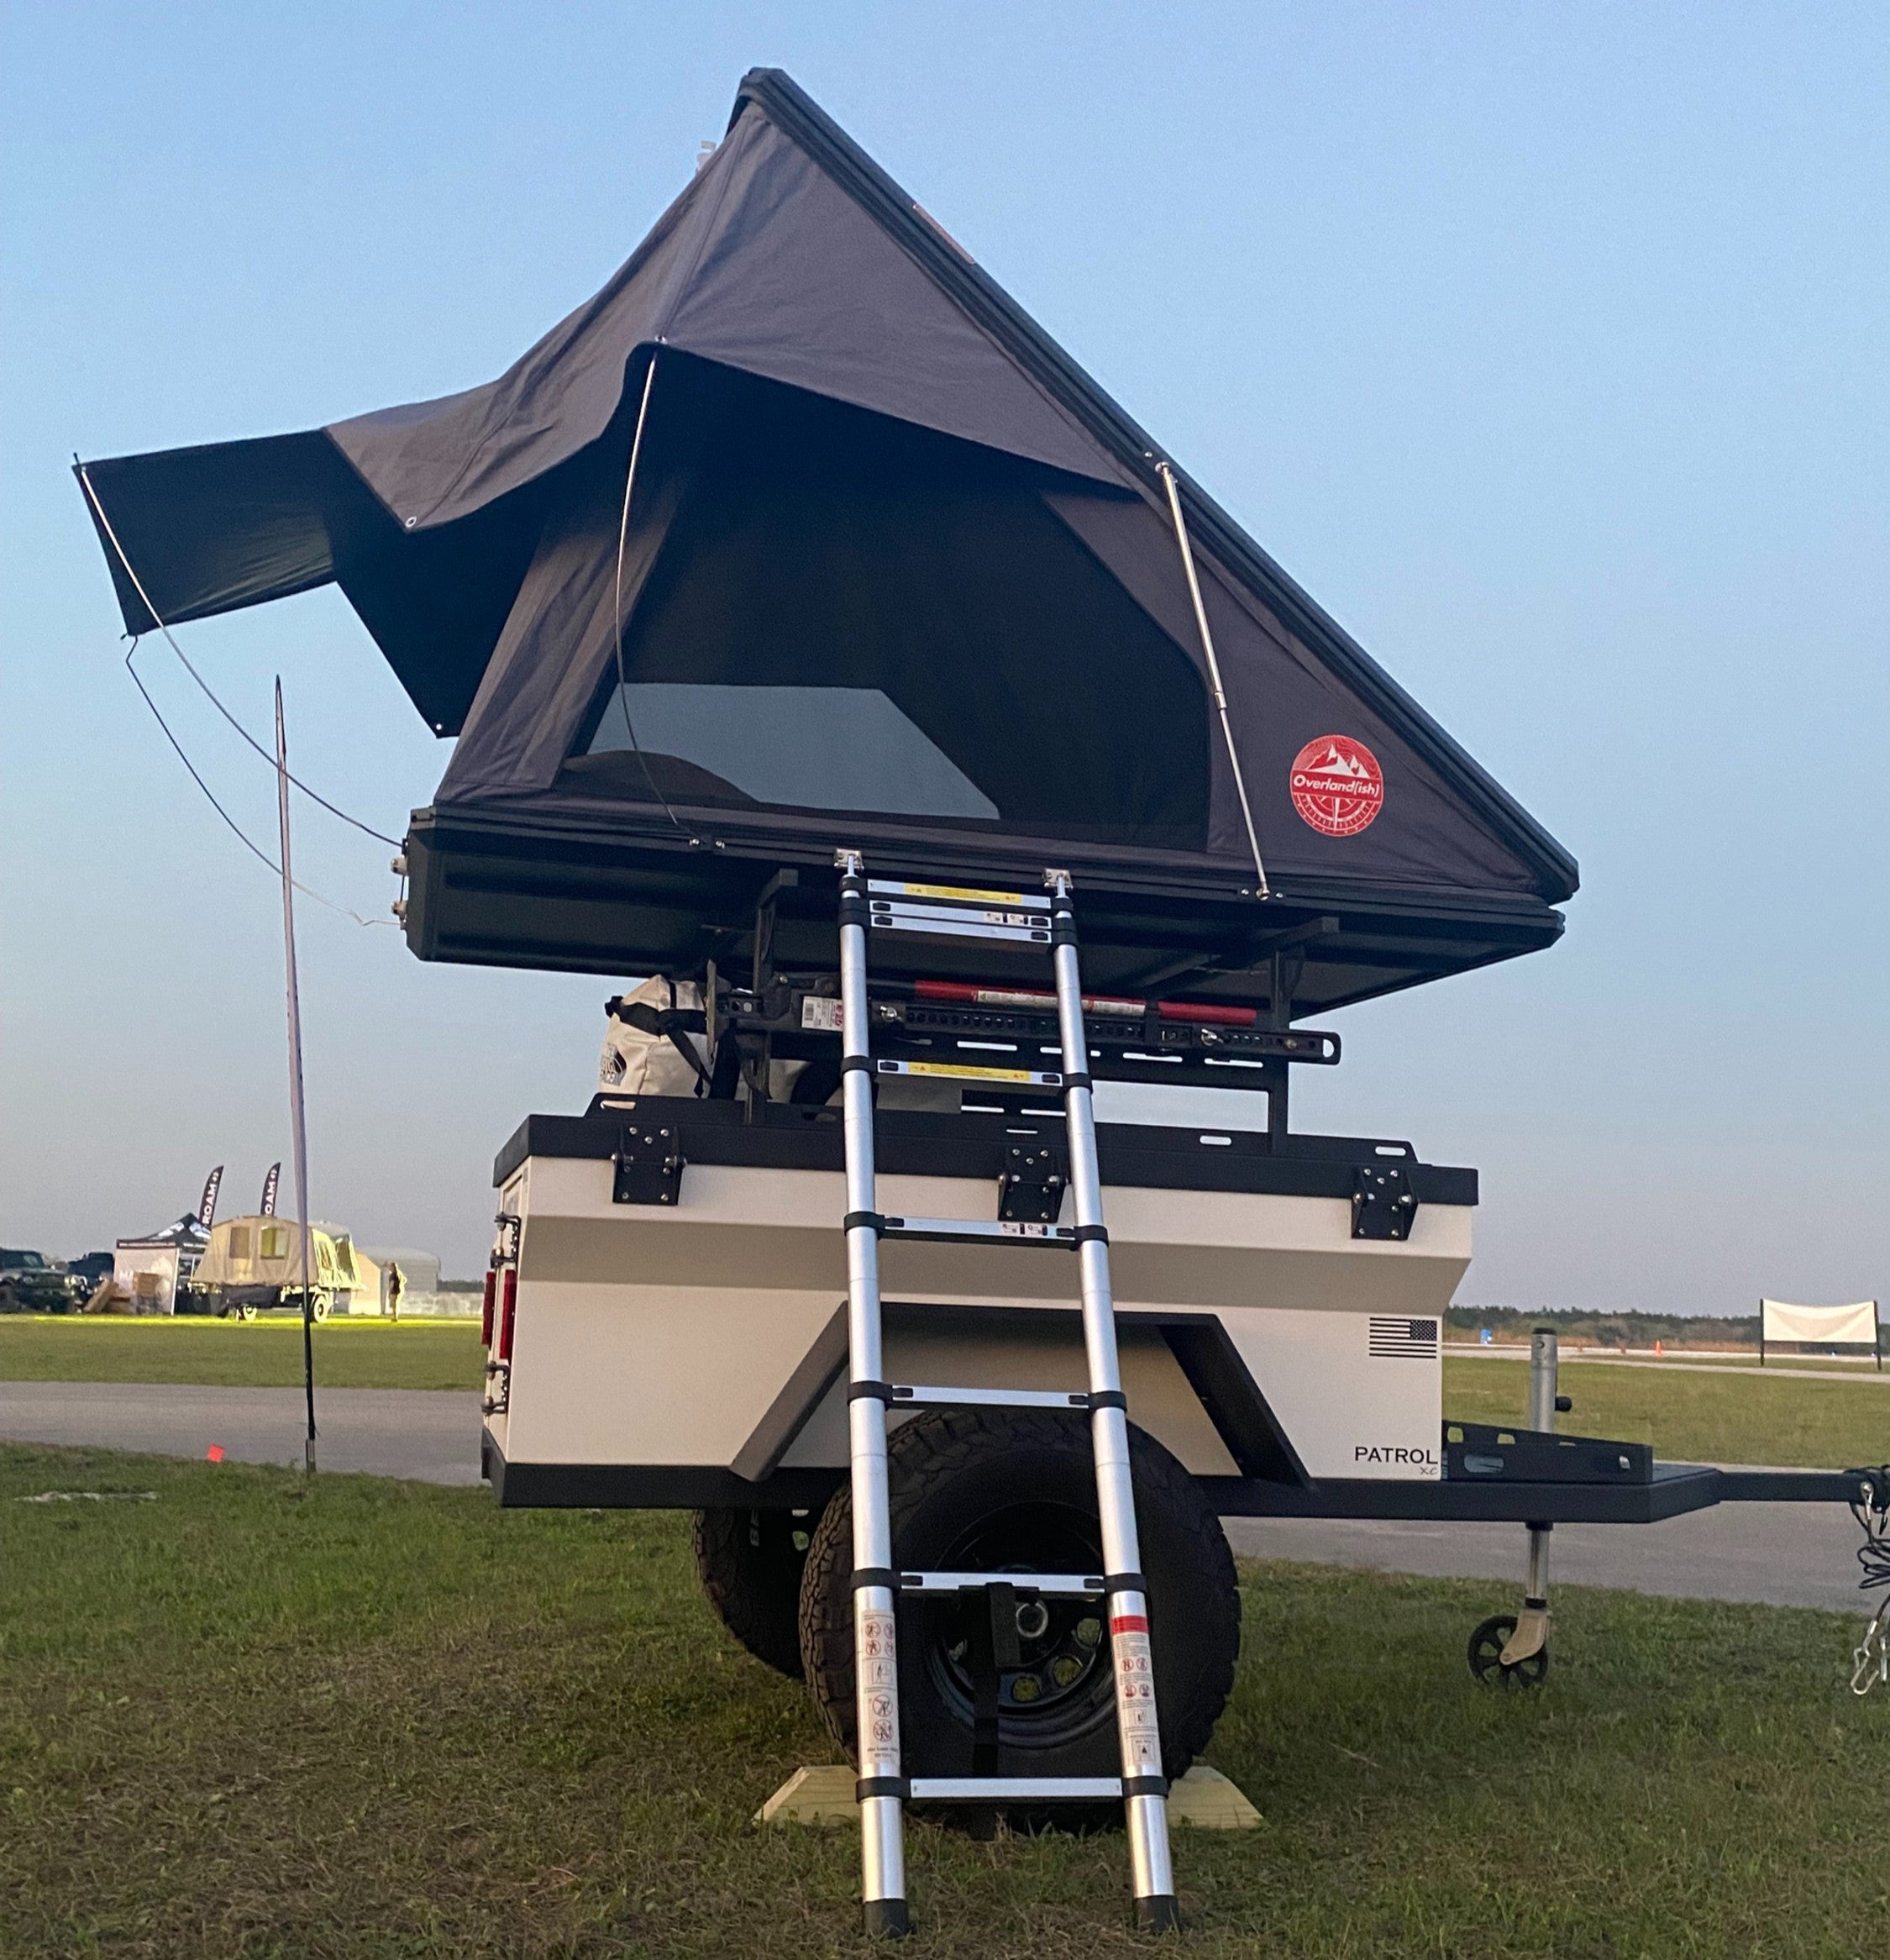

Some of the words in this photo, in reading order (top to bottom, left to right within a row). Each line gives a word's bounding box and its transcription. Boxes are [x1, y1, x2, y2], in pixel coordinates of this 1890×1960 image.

[1294, 775, 1379, 797] Overland(ish)
[202, 1183, 217, 1225] ROAM
[265, 1181, 276, 1216] OAM
[1355, 1446, 1438, 1464] PATROL
